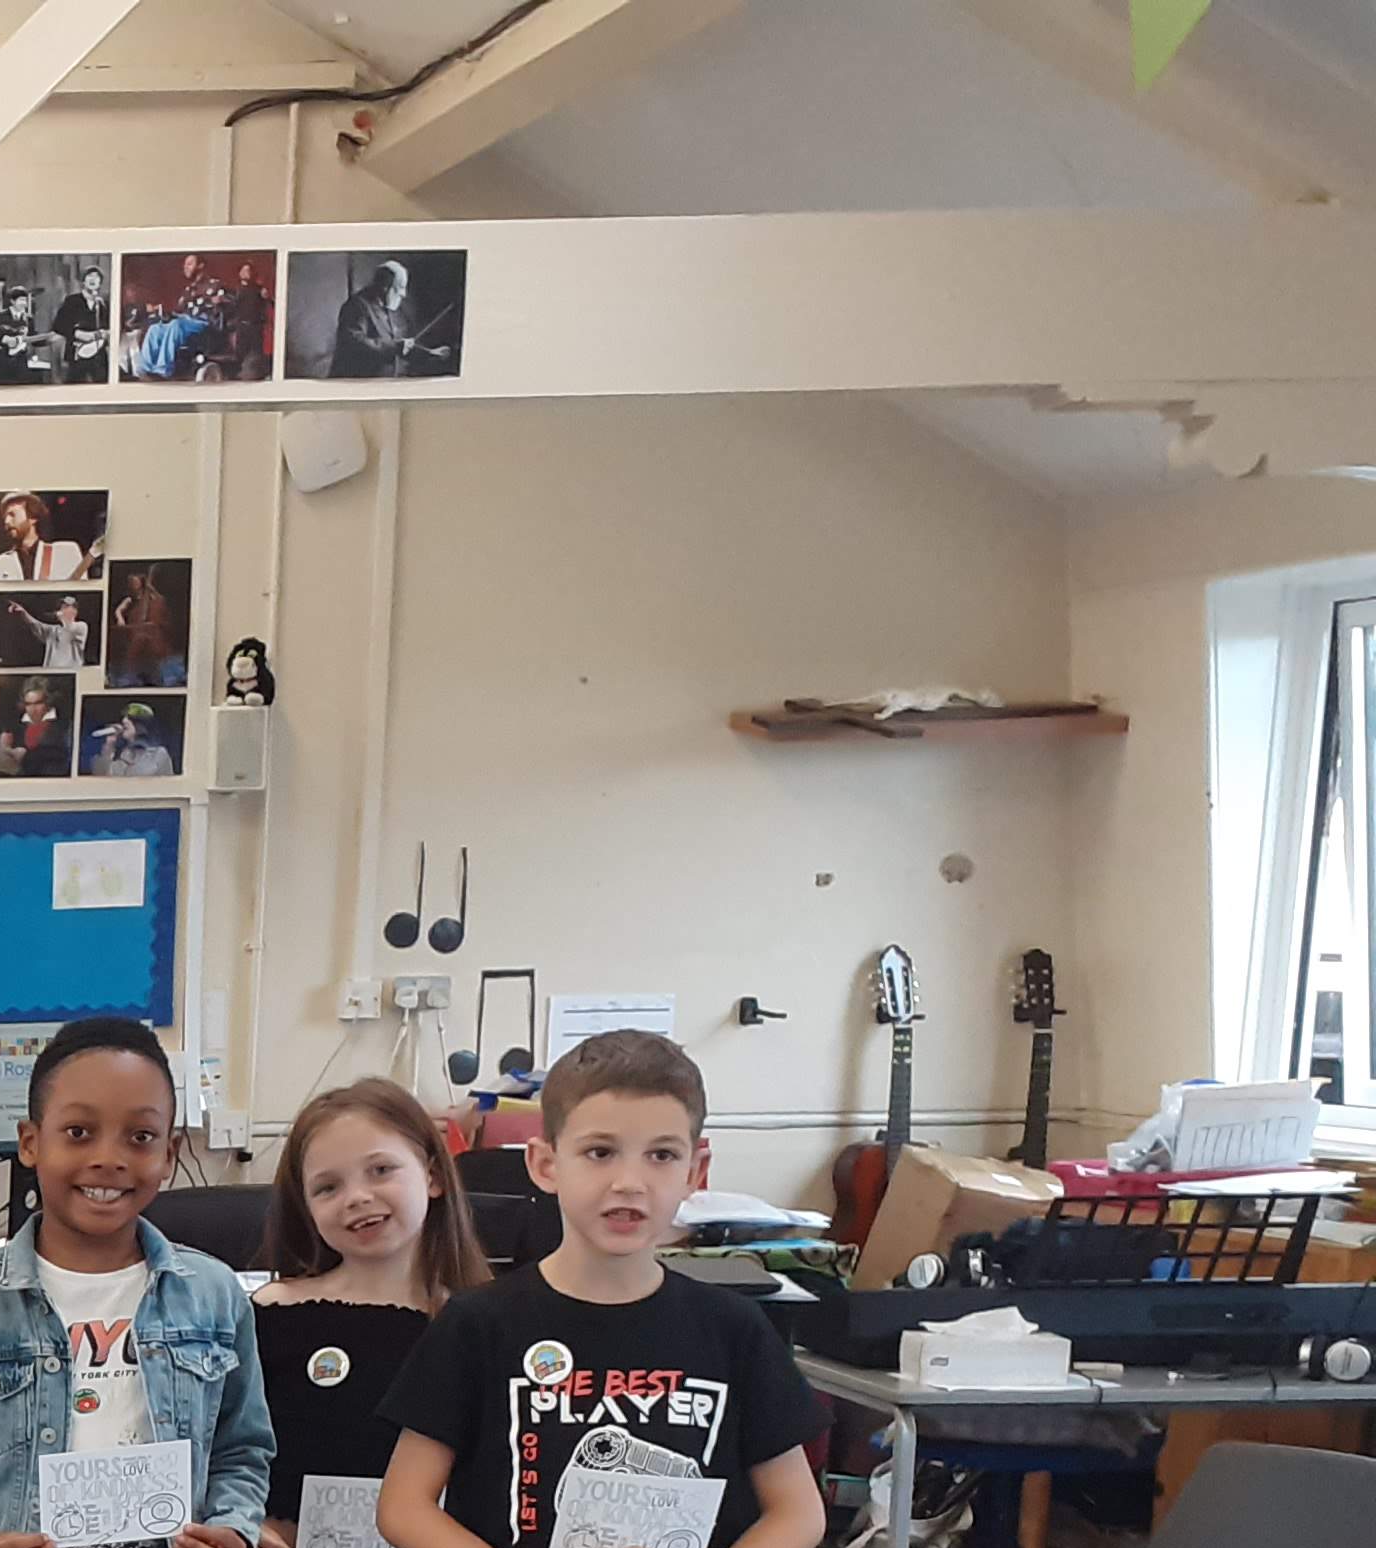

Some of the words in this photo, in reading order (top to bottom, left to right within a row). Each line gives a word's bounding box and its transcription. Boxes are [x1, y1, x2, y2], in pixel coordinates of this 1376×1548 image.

[3, 1060, 33, 1078] Ros
[539, 1370, 594, 1398] HE
[604, 1369, 686, 1398] BEST
[530, 1390, 715, 1429] PLAYER
[49, 1457, 121, 1484] YOURS
[312, 1485, 380, 1507] YOURS
[576, 1477, 651, 1505] YOURS
